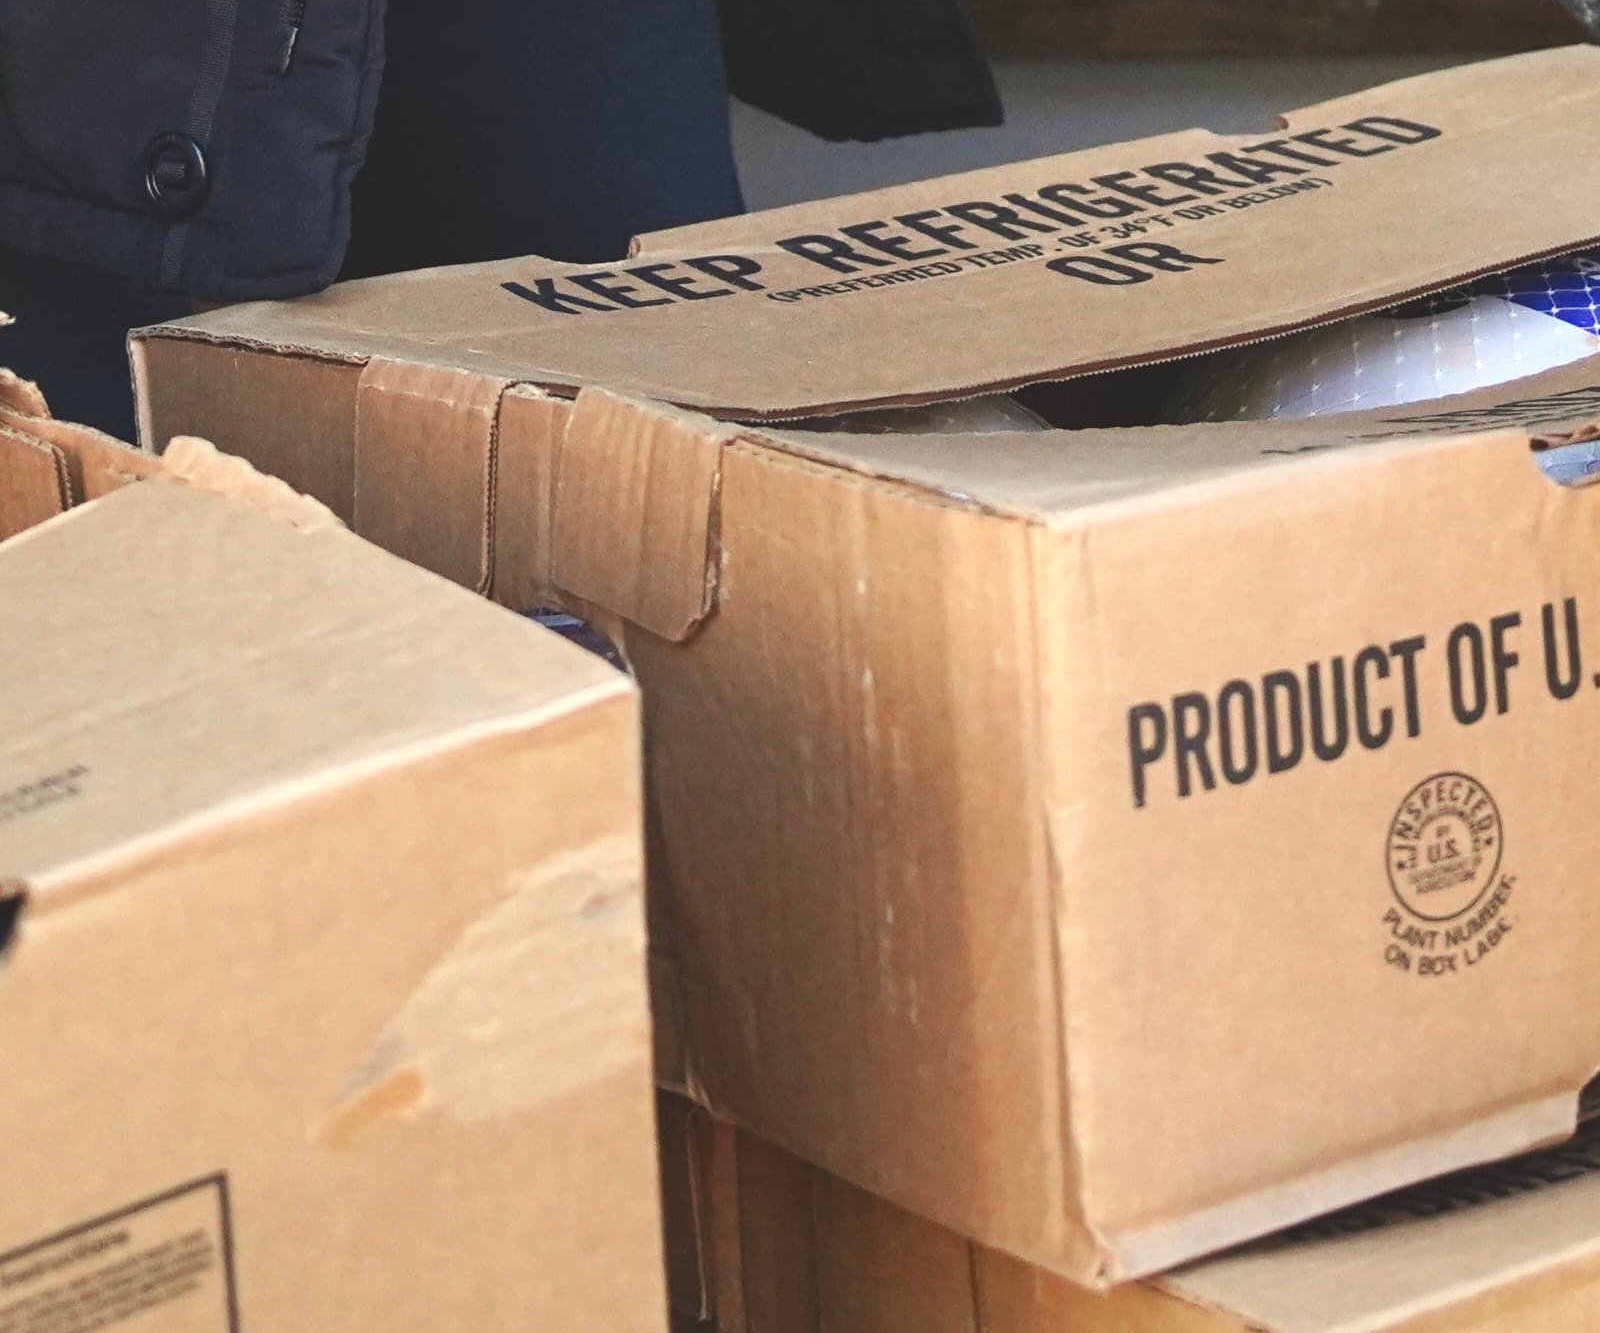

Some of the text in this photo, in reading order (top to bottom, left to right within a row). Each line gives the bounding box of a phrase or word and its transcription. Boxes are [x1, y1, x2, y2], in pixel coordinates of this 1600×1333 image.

[500, 116, 1443, 315] KEEP REFRIGERATED
[766, 260, 963, 303] (PREFERRED
[1058, 230, 1102, 249] OF
[1173, 201, 1226, 221] OR
[1218, 178, 1334, 211] BELOW)
[1045, 242, 1226, 286] OR
[1126, 634, 1426, 809] PRODUCT
[1446, 609, 1522, 726] OF
[1392, 780, 1494, 852] INSPECTED
[1463, 916, 1515, 967] LABE
